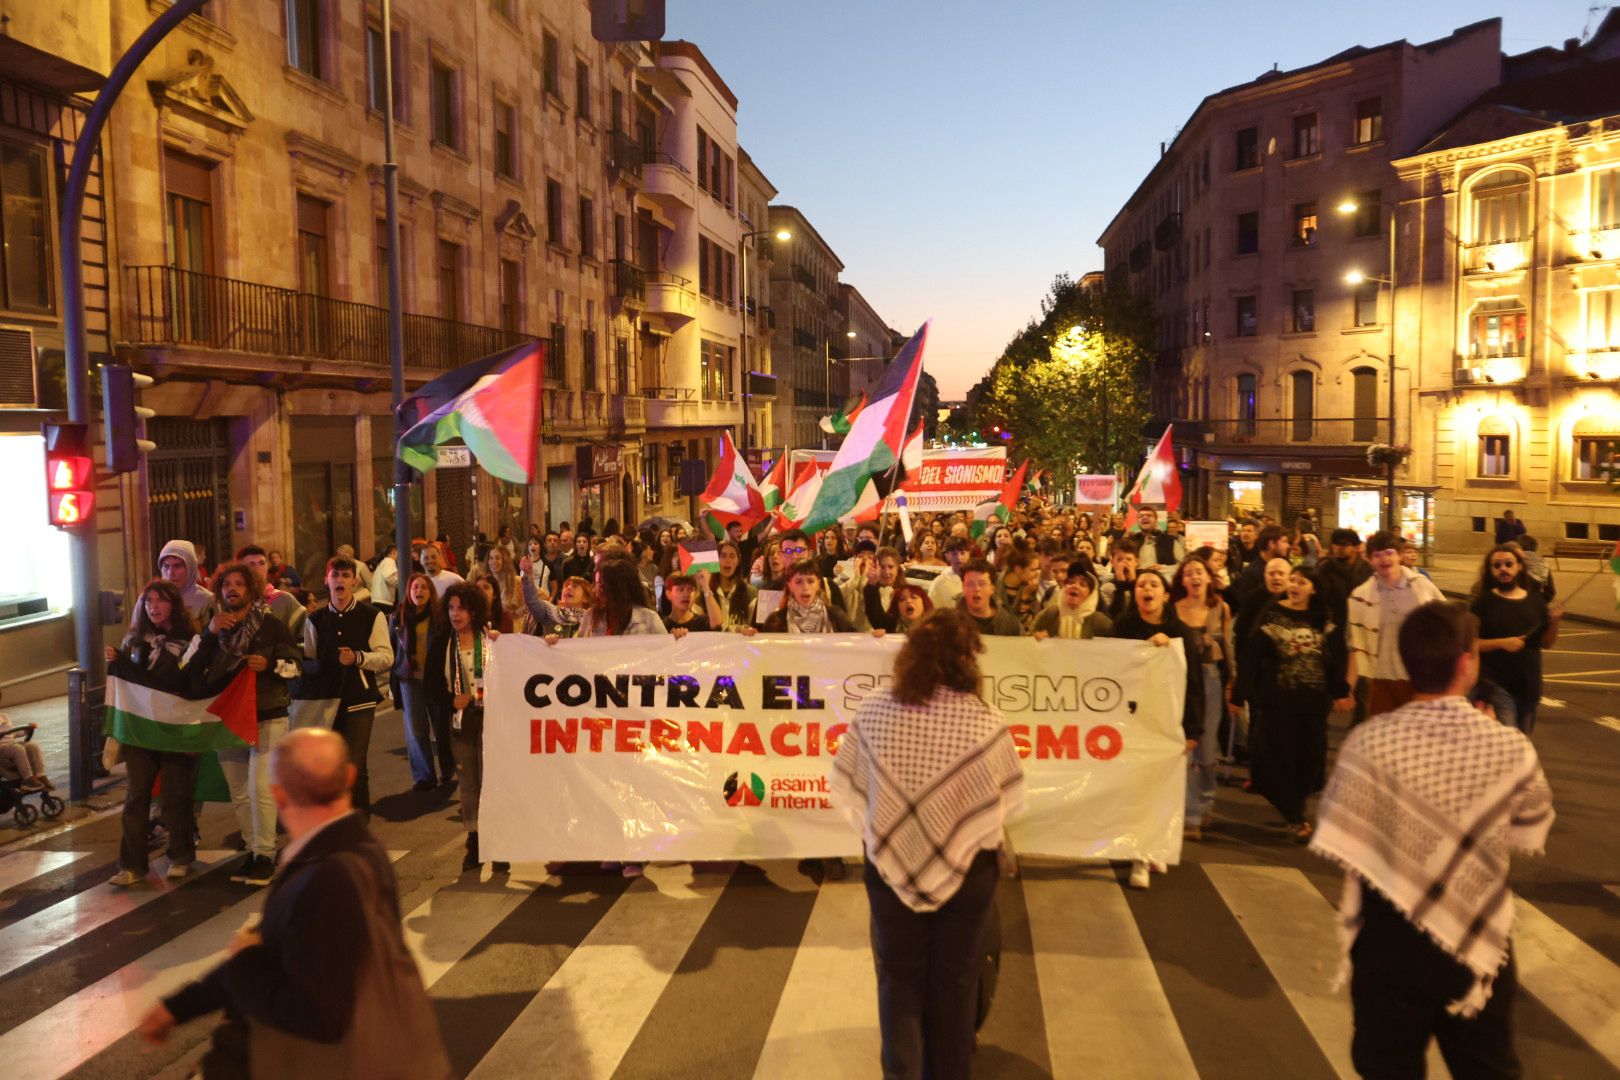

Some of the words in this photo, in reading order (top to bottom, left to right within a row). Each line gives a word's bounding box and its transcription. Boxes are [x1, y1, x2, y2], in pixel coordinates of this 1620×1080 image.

[921, 465, 941, 485] DEL
[523, 674, 744, 709] CONTRA
[762, 675, 825, 710] EL
